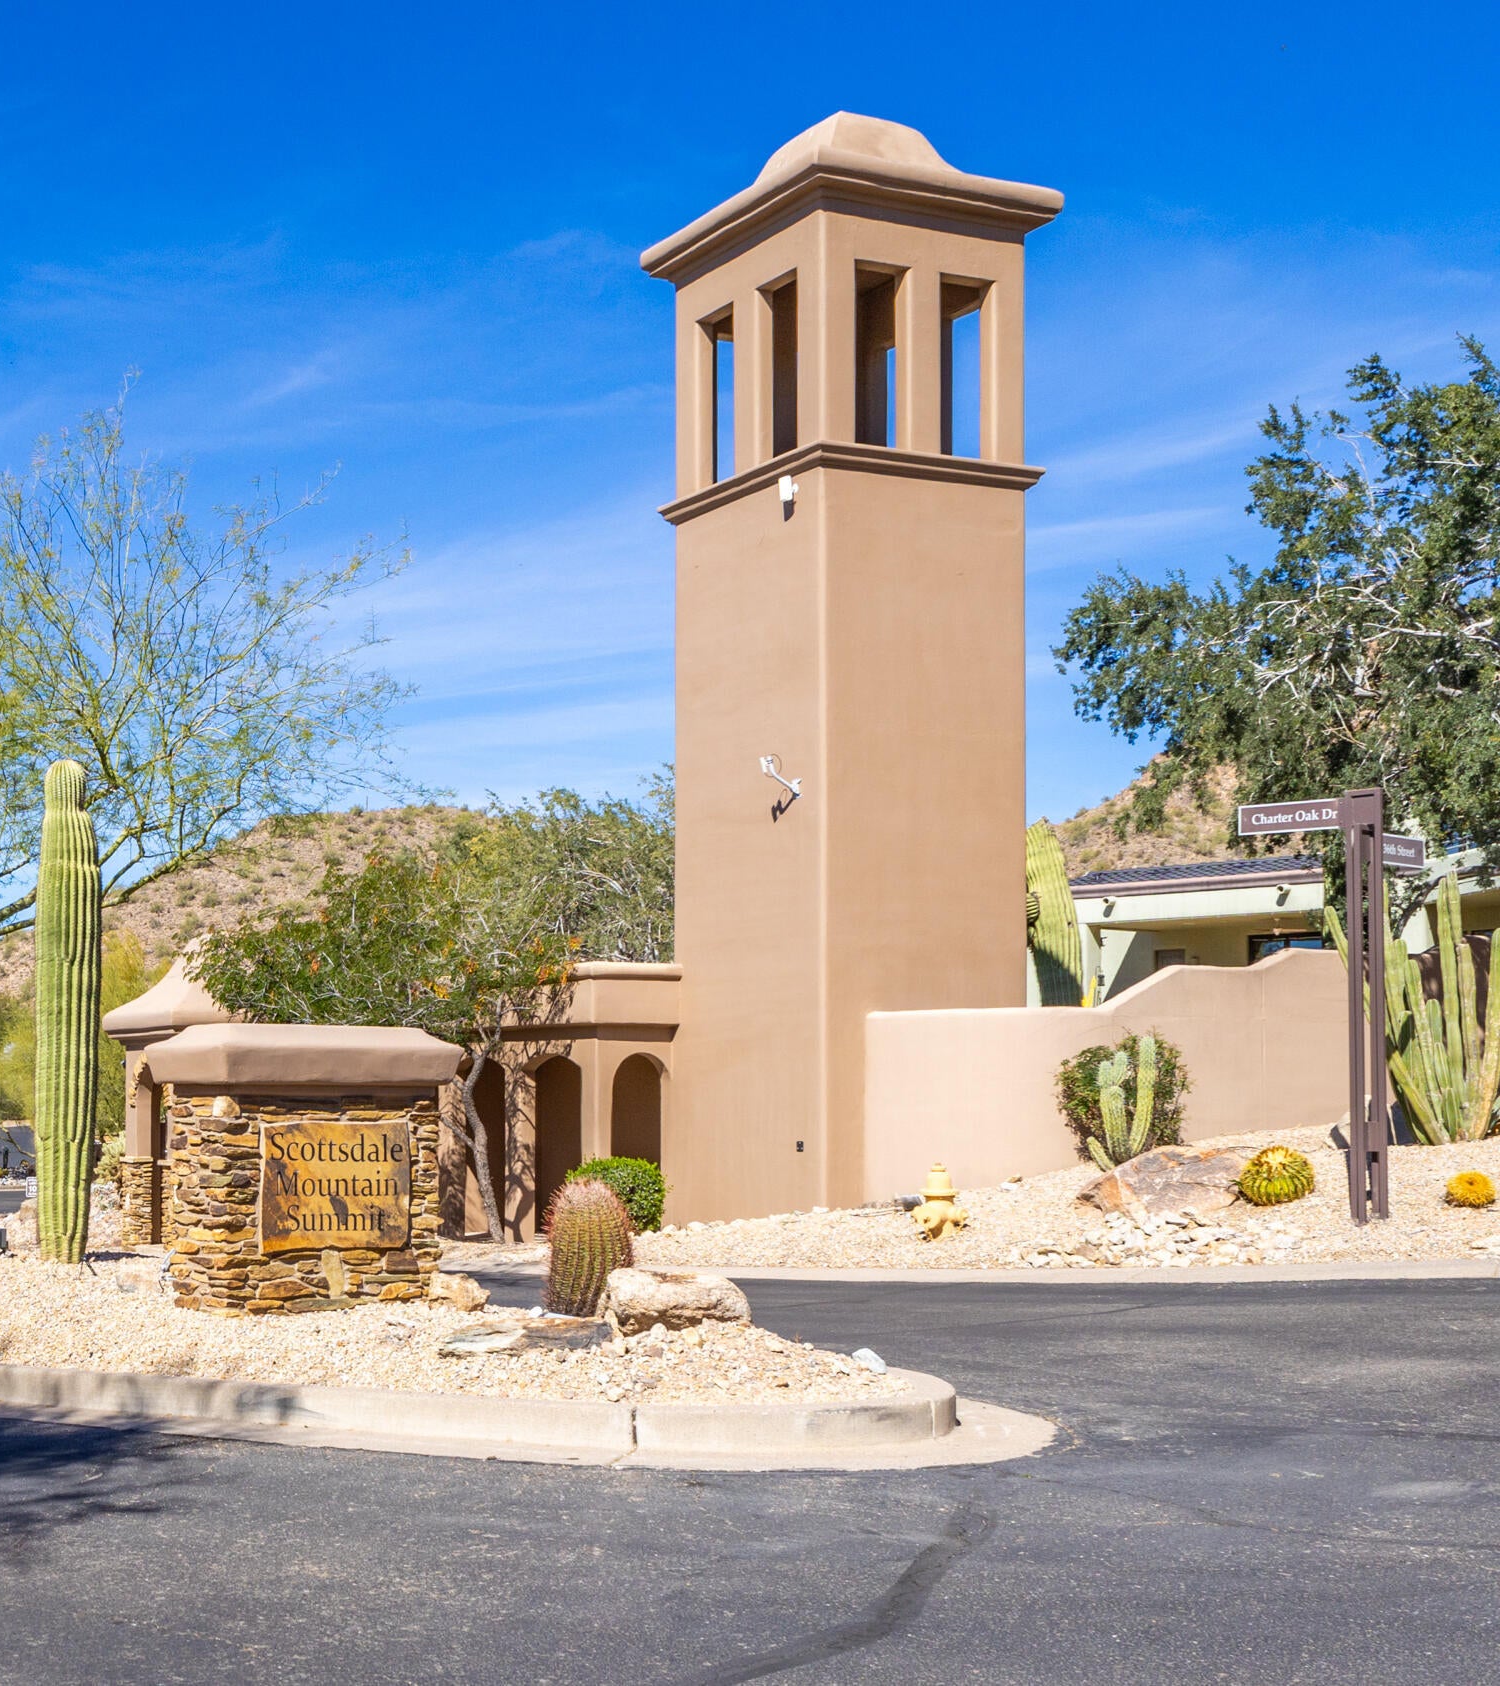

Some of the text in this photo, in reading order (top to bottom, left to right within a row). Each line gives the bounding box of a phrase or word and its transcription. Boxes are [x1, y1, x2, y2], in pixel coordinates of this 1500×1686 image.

[1251, 808, 1338, 826] Charter Oak Dr
[1397, 845, 1415, 857] Street
[270, 1132, 403, 1163] Scottsdale
[275, 1170, 398, 1197] Mountain
[287, 1203, 386, 1232] Summit
